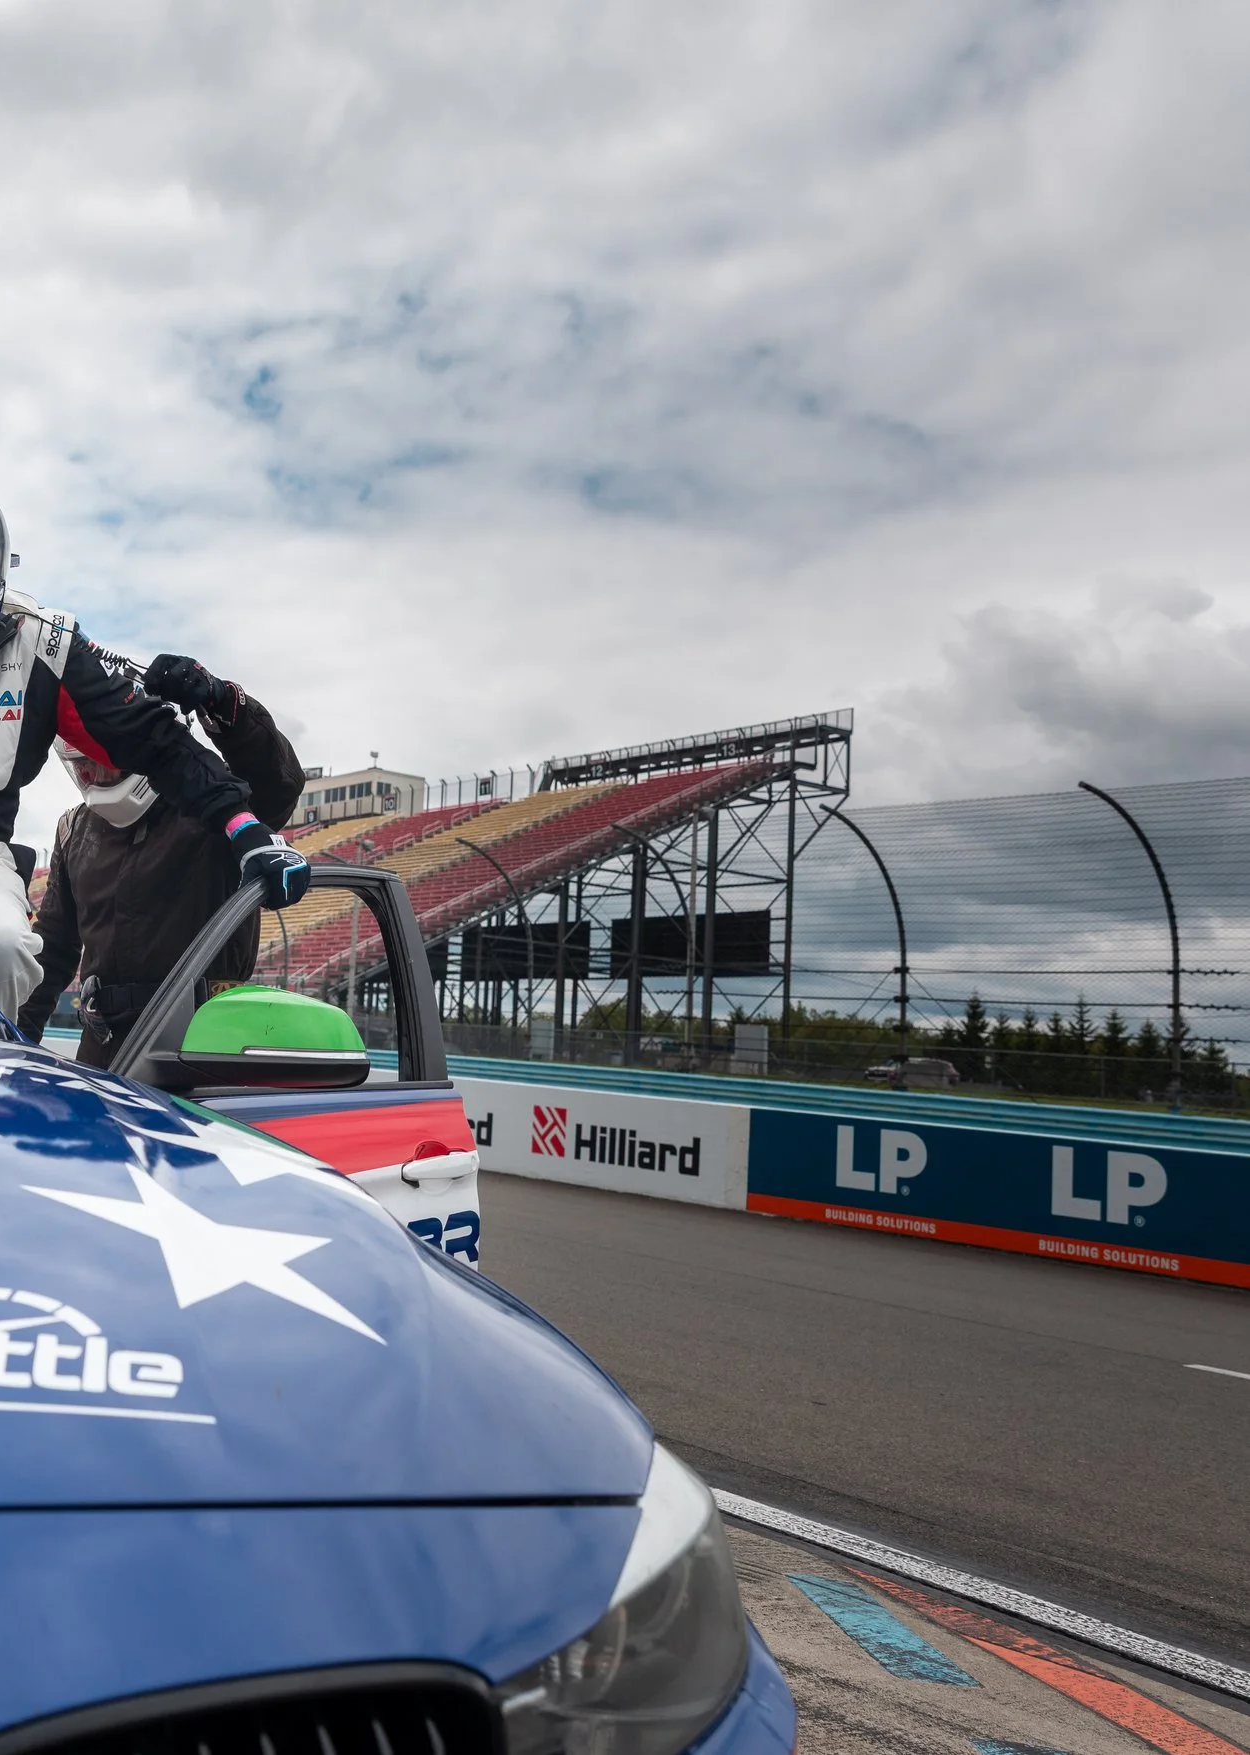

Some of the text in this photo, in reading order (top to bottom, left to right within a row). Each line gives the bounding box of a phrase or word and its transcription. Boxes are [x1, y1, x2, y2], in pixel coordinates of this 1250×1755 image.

[45, 614, 65, 659] sparco
[574, 1123, 701, 1177] Hilliard
[825, 1208, 937, 1234] BUILDING SOLUTIONS
[1038, 1239, 1180, 1272] BUILDING SOLUTIONS
